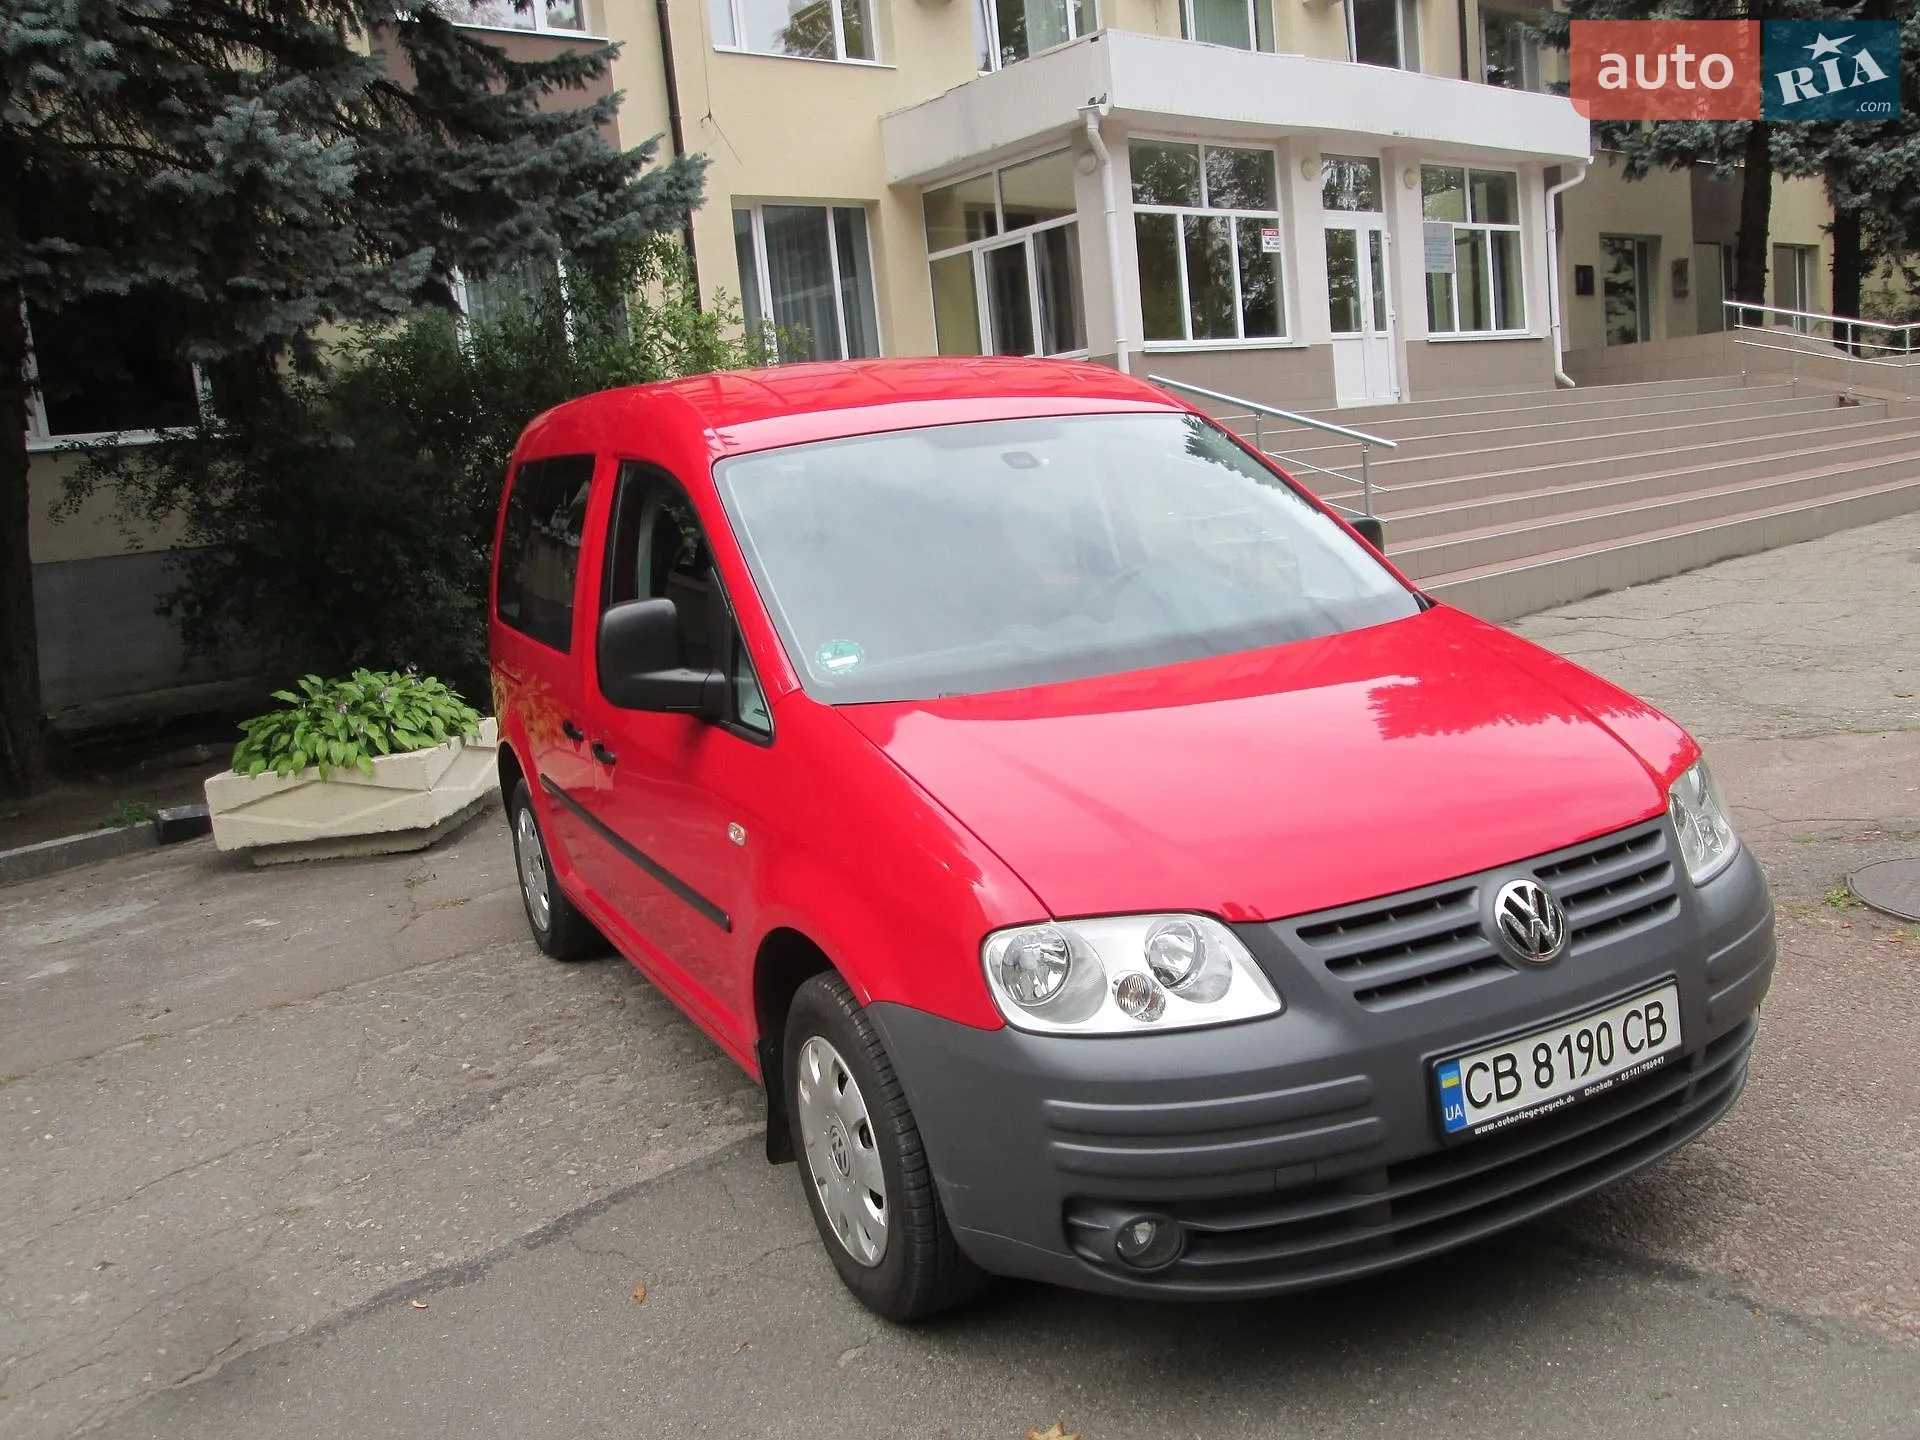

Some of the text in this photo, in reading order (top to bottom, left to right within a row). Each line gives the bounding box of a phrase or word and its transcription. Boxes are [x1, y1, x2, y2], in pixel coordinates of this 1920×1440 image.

[1495, 880, 1563, 961] VW
[1465, 1001, 1667, 1109] CB 8190 CB
[1445, 1105, 1463, 1121] UA
